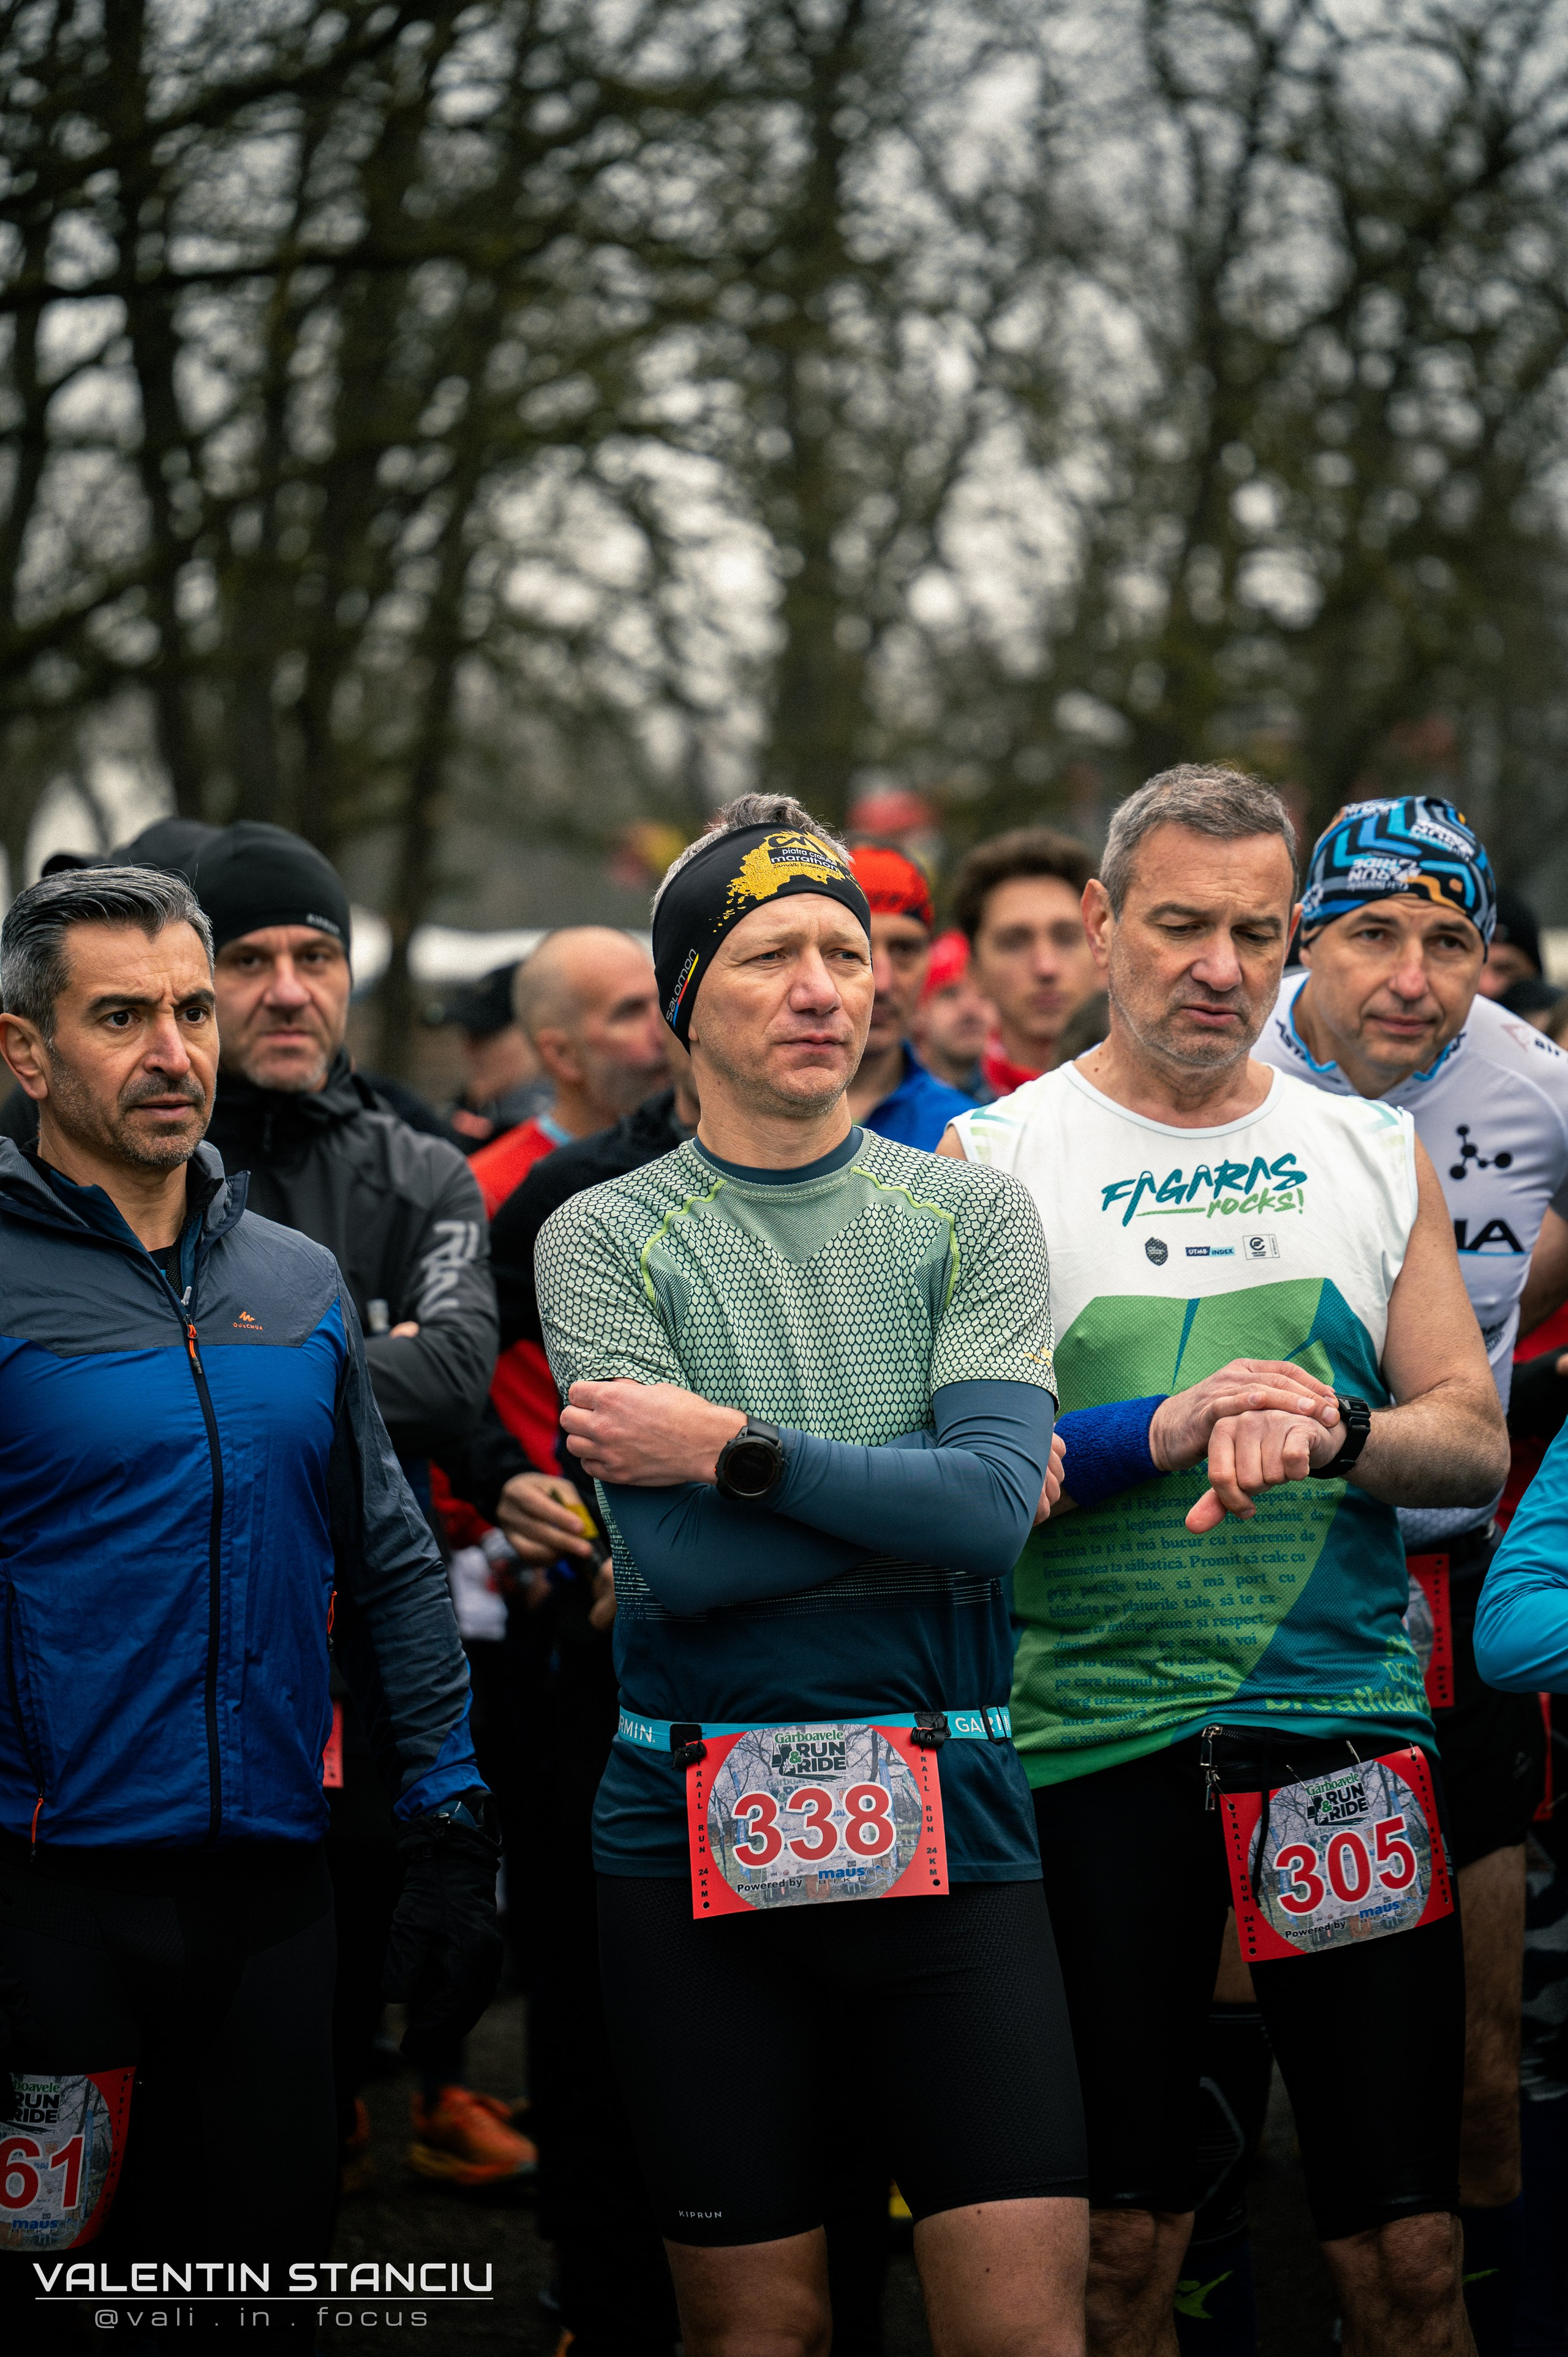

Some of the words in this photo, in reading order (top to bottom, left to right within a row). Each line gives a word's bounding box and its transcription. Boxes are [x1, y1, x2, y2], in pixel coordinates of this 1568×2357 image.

[771, 854, 838, 872] marathon
[1207, 1188, 1304, 1218] rocks!
[233, 1322, 263, 1330] QUECHUA
[1311, 1509, 1324, 1520] de
[1090, 1544, 1102, 1554] ta
[1136, 1537, 1156, 1550] mă
[1161, 1536, 1204, 1550] bucur
[1210, 1536, 1227, 1547] cu
[1232, 1529, 1296, 1544] smerenie
[1300, 1529, 1316, 1542] de
[1111, 1562, 1122, 1572] ta
[1190, 1552, 1242, 1567] Promit
[1243, 1551, 1258, 1564] să
[1261, 1550, 1289, 1563] calc
[1291, 1553, 1306, 1563] cu
[1135, 1578, 1164, 1592] tale,
[1176, 1576, 1191, 1590] să
[1203, 1574, 1224, 1586] mă
[1235, 1573, 1267, 1589] port
[1278, 1573, 1296, 1583] cu
[1104, 1603, 1118, 1618] pe
[1183, 1595, 1215, 1608] tale,
[1220, 1593, 1234, 1606] să
[1239, 1594, 1254, 1605] te
[1259, 1594, 1282, 1604] ex-
[1213, 1613, 1269, 1630] respect.
[1158, 1640, 1174, 1652] pe
[1215, 1634, 1229, 1646] le
[1234, 1632, 1257, 1645] voi
[1055, 1678, 1070, 1692] pe
[1074, 1678, 1102, 1687] care
[1218, 1670, 1231, 1680] le
[775, 1730, 843, 1743] Gârboavele
[789, 1751, 802, 1763] &
[796, 1741, 846, 1757] RUN
[797, 1756, 846, 1773] RIDE
[1306, 1772, 1360, 1795] Gârboavele
[1325, 1782, 1365, 1805] RUN
[1322, 1800, 1332, 1812] &
[1330, 1797, 1369, 1821] RIDE
[732, 1782, 896, 1869] 338
[818, 1866, 865, 1879] maus
[1273, 1813, 1418, 1916] 305
[737, 1878, 785, 1891] Powered
[789, 1878, 803, 1888] by
[1360, 1900, 1400, 1918] maus
[1360, 1908, 1401, 1923] BIKE
[1285, 1924, 1331, 1938] Powered
[1334, 1920, 1346, 1930] by
[14, 2091, 60, 2108] RUN
[12, 2108, 58, 2124] RIDE
[678, 2210, 722, 2219] KIPRUN
[12, 2219, 58, 2229] maus
